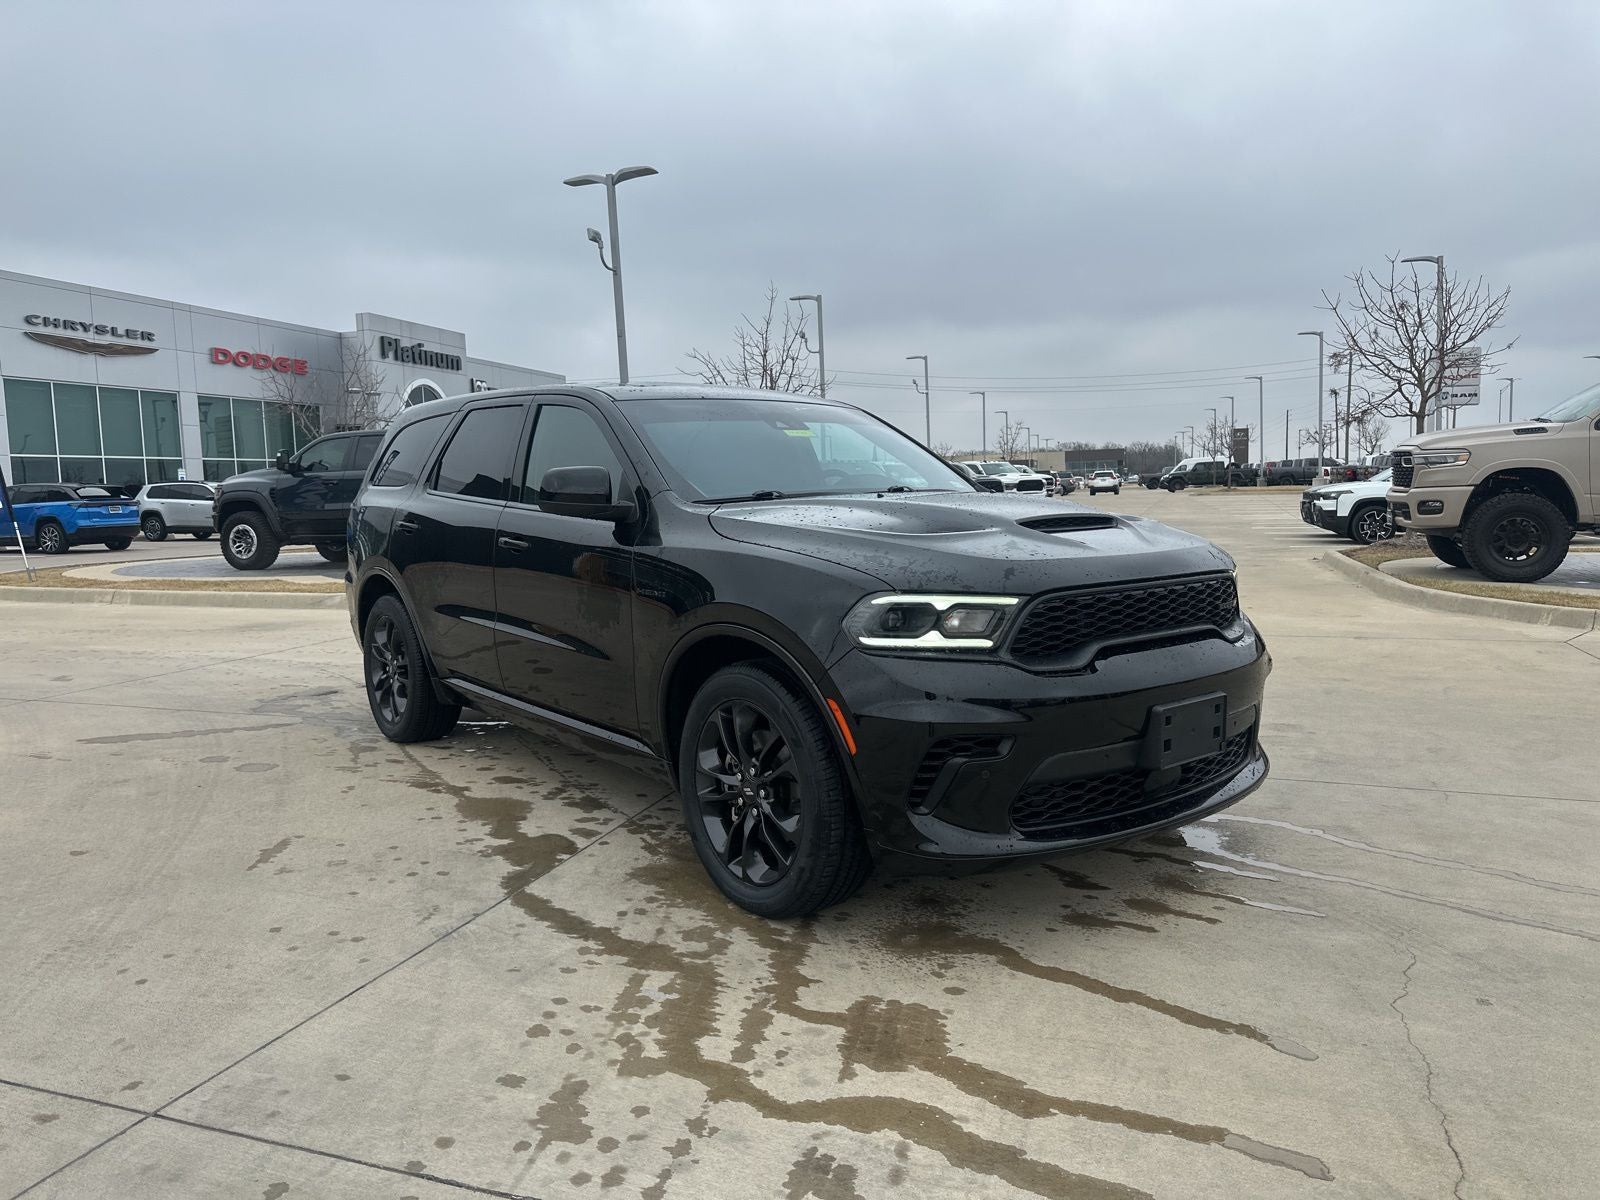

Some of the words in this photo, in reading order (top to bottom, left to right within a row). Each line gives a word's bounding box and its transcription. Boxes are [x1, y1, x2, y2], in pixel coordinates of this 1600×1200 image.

[24, 314, 156, 342] CHRYSLER
[210, 347, 308, 375] DODGE
[380, 335, 463, 371] Platinum
